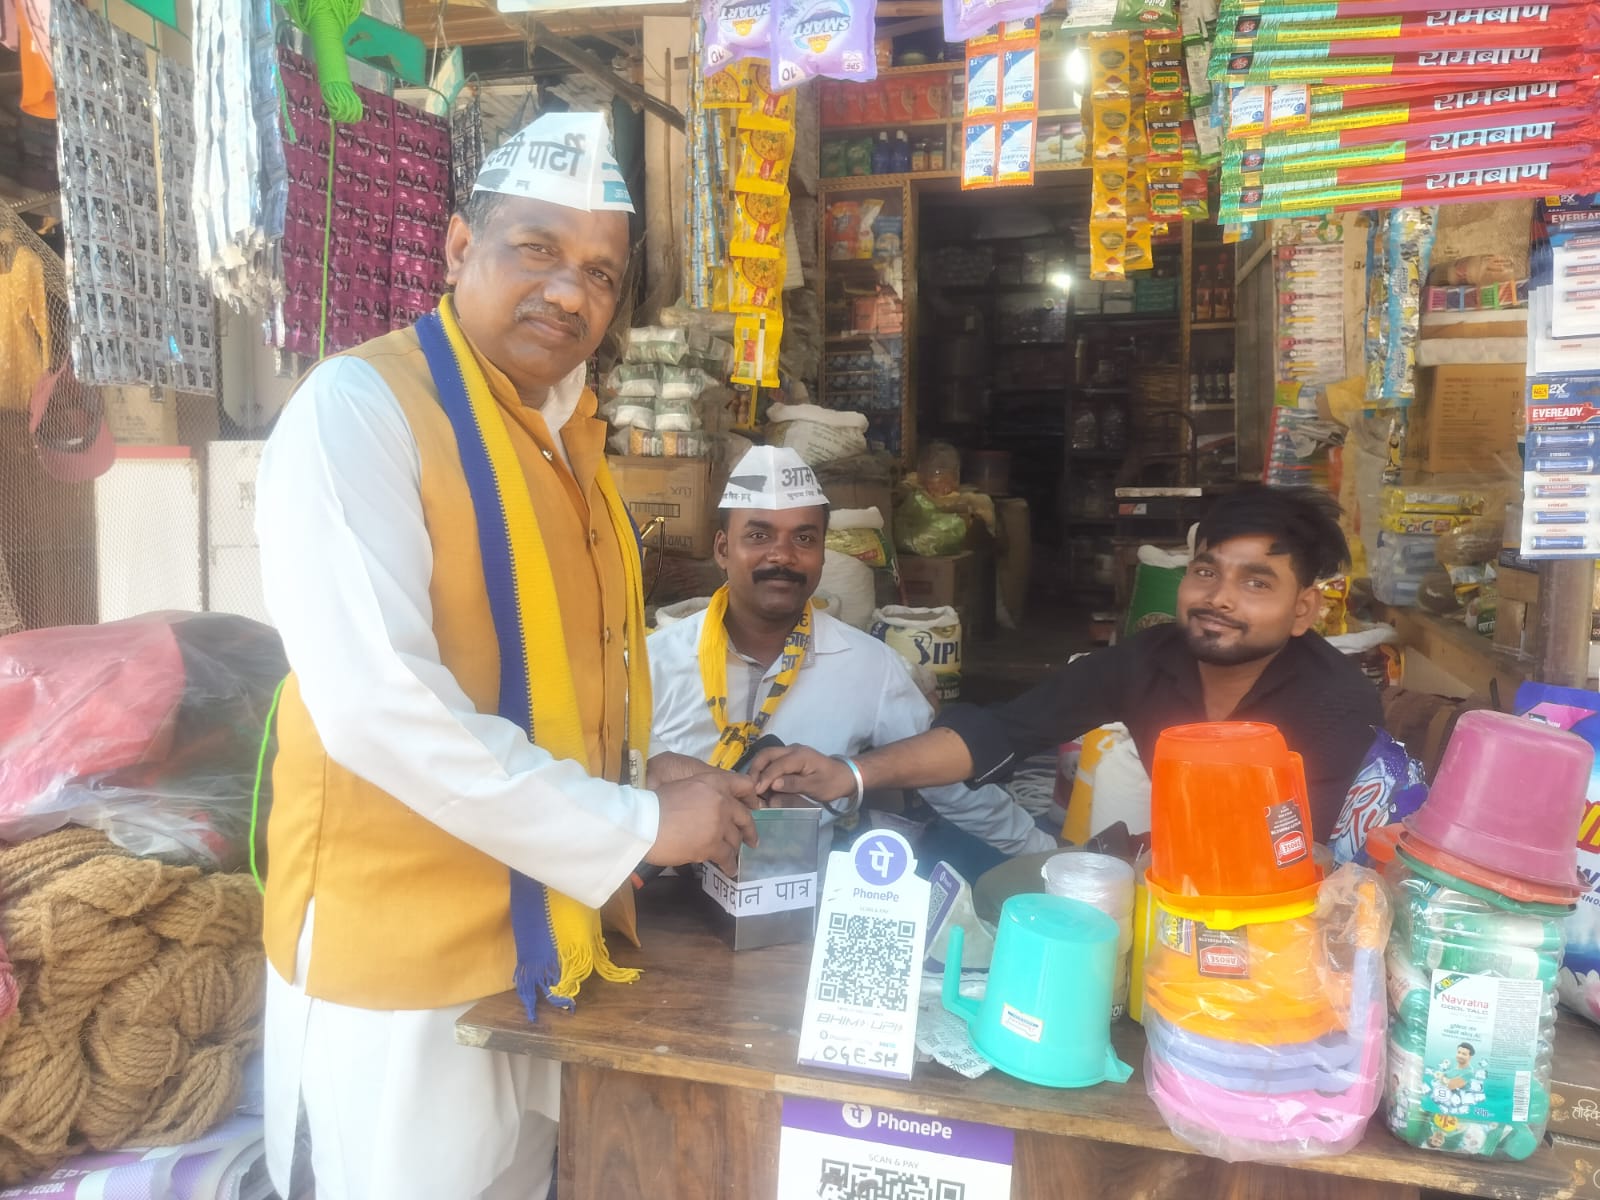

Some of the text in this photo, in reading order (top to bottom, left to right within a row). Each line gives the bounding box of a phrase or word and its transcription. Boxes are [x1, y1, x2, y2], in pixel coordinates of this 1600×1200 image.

[719, 2, 771, 20] SMART
[1426, 5, 1549, 27] रामबाण
[793, 16, 850, 36] SMART
[1418, 47, 1543, 66] रामबाण
[782, 66, 796, 82] 10
[1434, 80, 1560, 110] रामबाण
[1430, 121, 1556, 151] रामबाण
[528, 132, 586, 176] पार्टी
[1426, 161, 1551, 190] रामबाण
[1549, 382, 1568, 394] 2X
[1532, 406, 1583, 418] EVEREADY
[781, 466, 814, 487] आम
[775, 878, 812, 901] पात्र
[853, 887, 900, 903] PhonePe
[1441, 993, 1489, 1009] Navratna
[877, 1111, 953, 1139] PhonePe
[868, 1153, 894, 1165] SCAN
[902, 1159, 920, 1169] PAY
